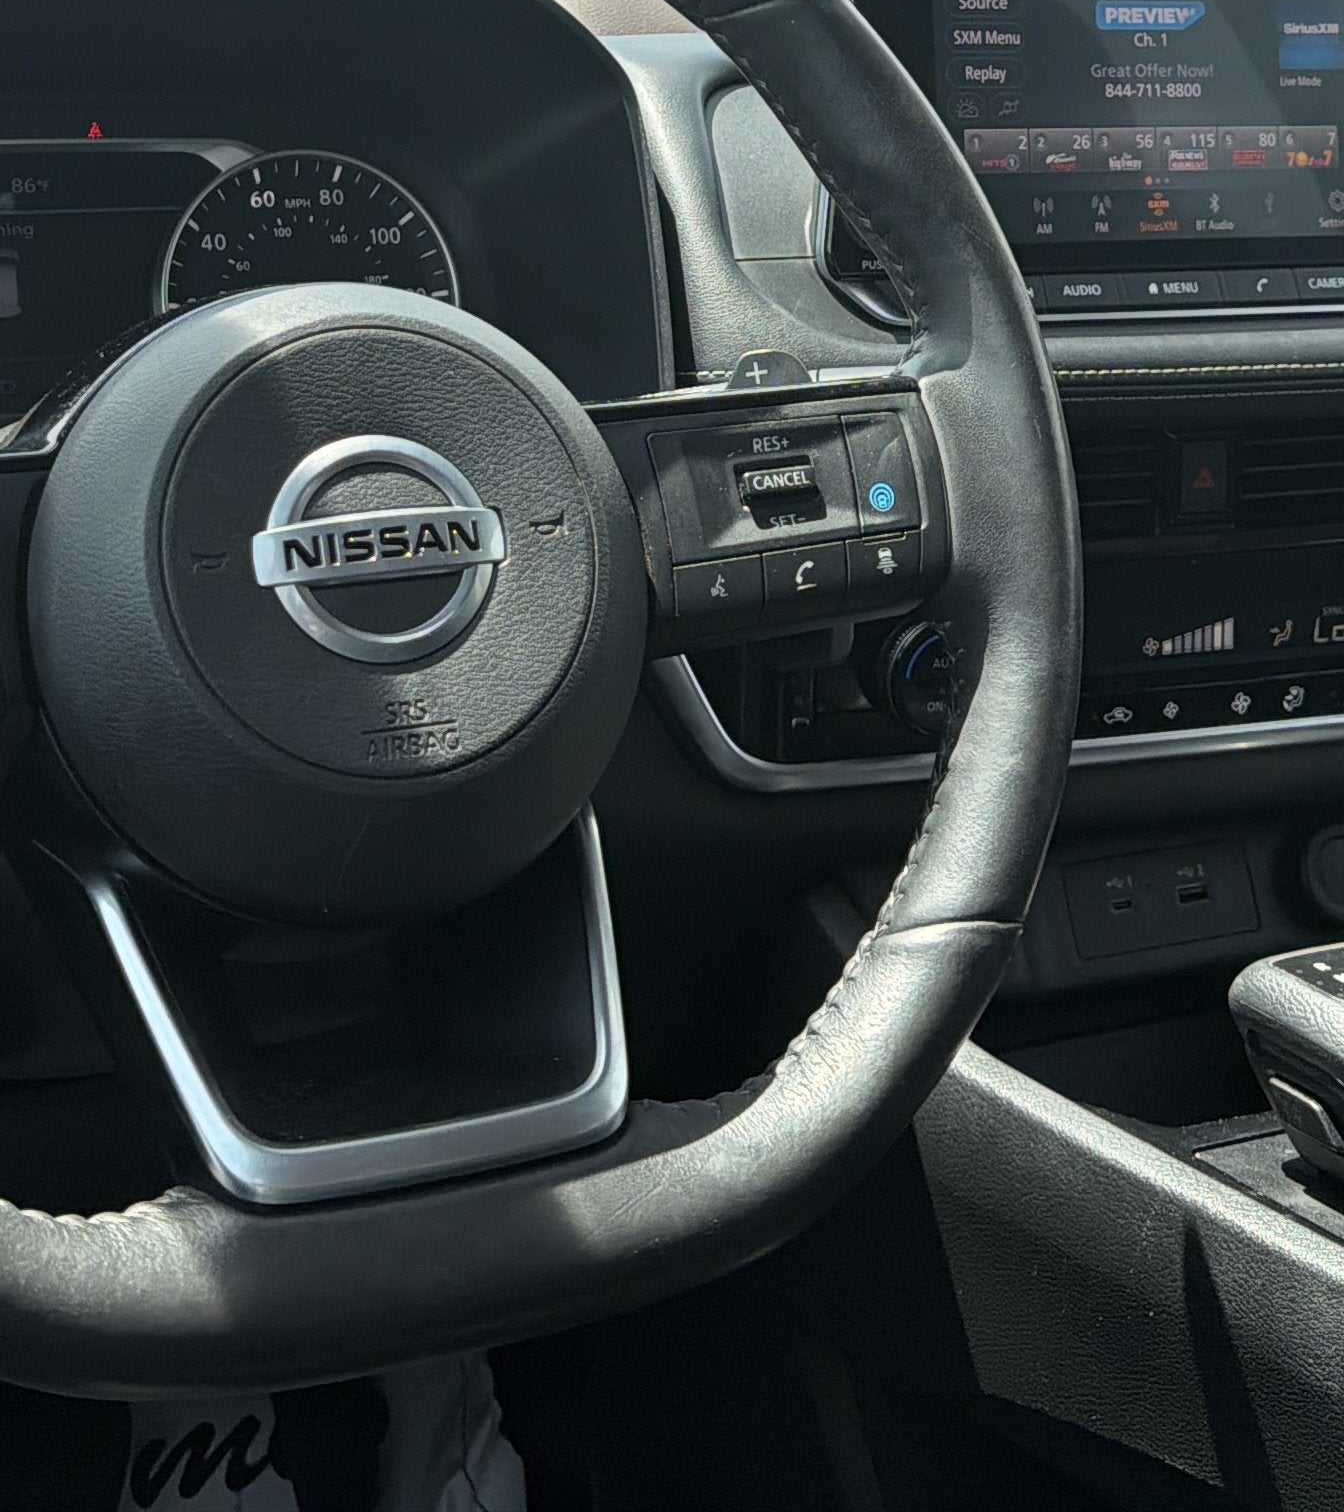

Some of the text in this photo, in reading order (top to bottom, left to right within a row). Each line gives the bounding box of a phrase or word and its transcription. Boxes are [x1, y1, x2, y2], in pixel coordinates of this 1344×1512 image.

[1104, 7, 1196, 25] PREVIEW
[953, 29, 1021, 46] SXM Menu
[1134, 32, 1168, 49] Ch. 1
[964, 65, 1007, 85] Replay
[1090, 62, 1215, 79] Great Offer Now!
[1297, 75, 1322, 87] Mode
[1104, 81, 1202, 99] 844-711-8800
[1018, 135, 1028, 151] 2
[1036, 137, 1045, 148] 2
[1072, 135, 1091, 150] 26
[1135, 134, 1154, 149] 56
[1163, 135, 1172, 146] 4
[1190, 133, 1216, 148] 115
[1225, 134, 1232, 145] 5
[1258, 133, 1276, 147] 80
[1286, 134, 1294, 145] 6
[1326, 132, 1336, 145] 7
[250, 190, 276, 208] 60
[284, 197, 311, 210] MPH
[319, 188, 345, 206] 80
[273, 227, 292, 238] 100
[1036, 223, 1053, 235] AM
[1095, 222, 1109, 233] FM
[1196, 220, 1235, 231] BT Audio
[201, 233, 227, 251] 40
[330, 234, 348, 245] 140
[369, 227, 401, 245] 100
[236, 261, 251, 272] 60
[861, 260, 884, 271] PUS
[1062, 283, 1103, 297] AUDIO
[1162, 281, 1200, 296] MENU
[752, 471, 810, 490] CANCEL
[283, 519, 482, 573] NISSAN
[1323, 606, 1344, 616] SYNC
[385, 697, 428, 725] SRS
[368, 729, 462, 763] AIRBAG
